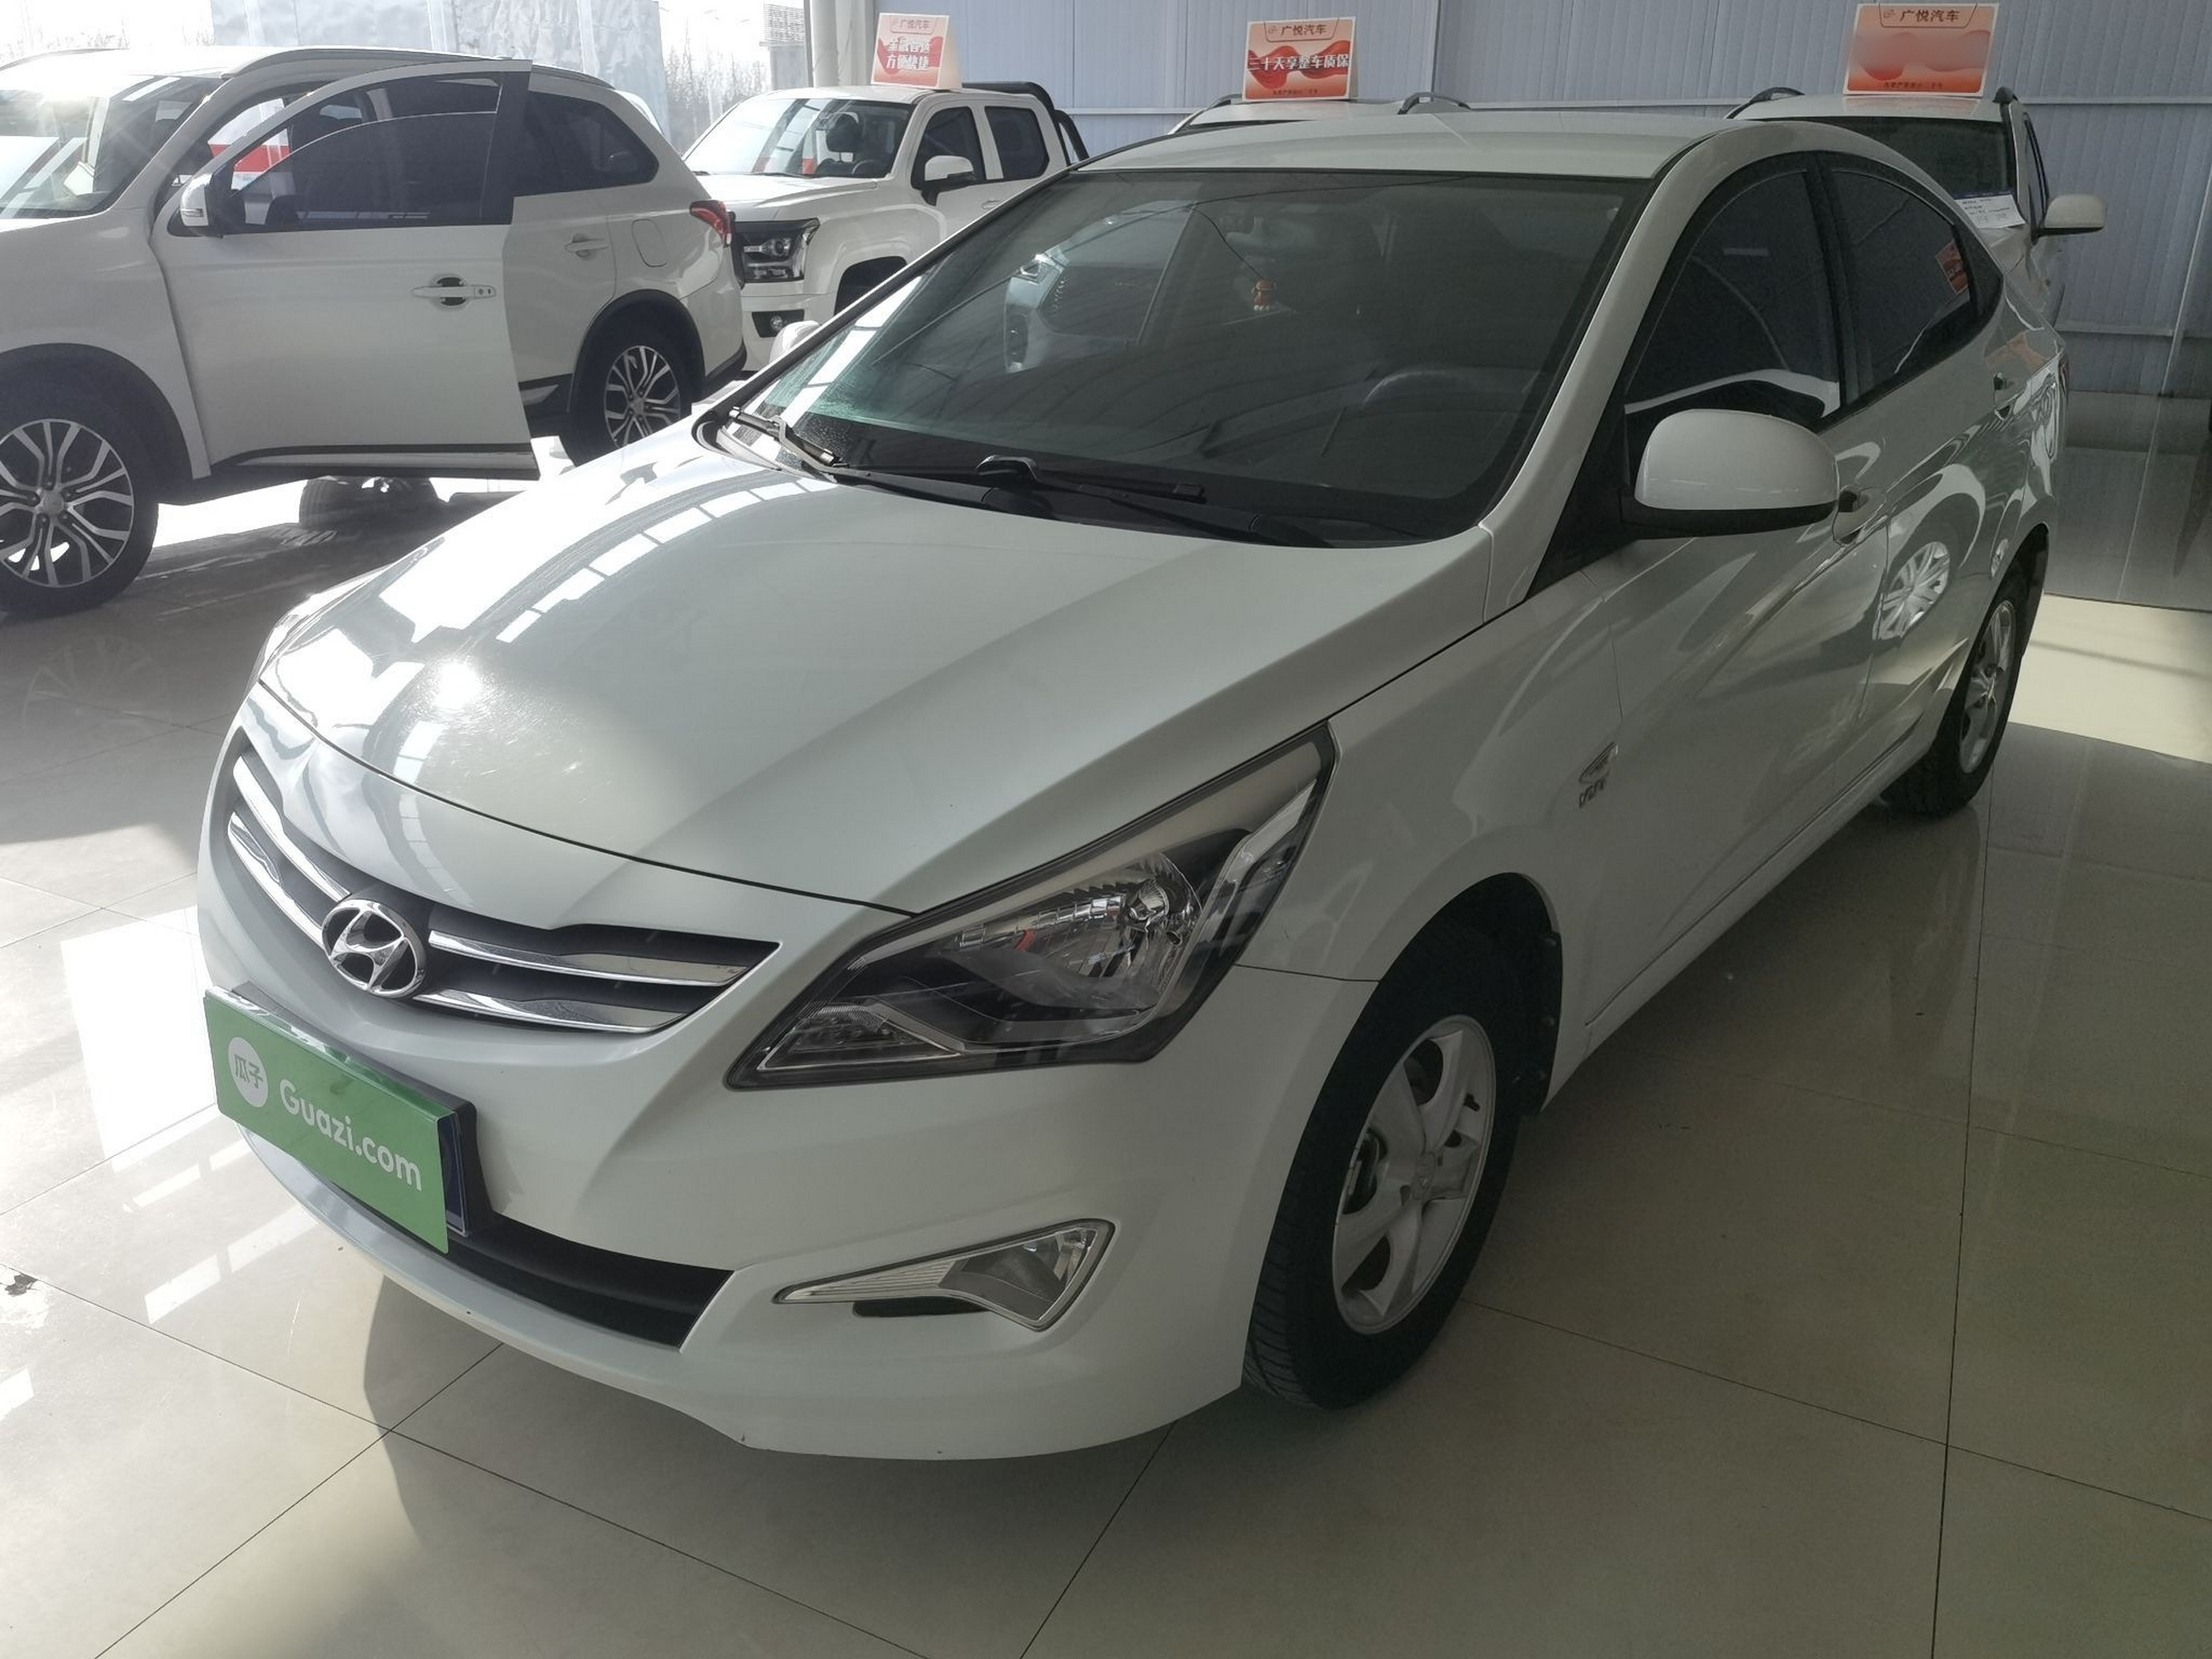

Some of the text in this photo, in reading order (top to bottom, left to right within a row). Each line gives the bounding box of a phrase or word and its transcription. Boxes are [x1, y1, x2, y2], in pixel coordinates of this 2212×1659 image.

[1900, 9, 1960, 22] 广悦汽车
[1280, 24, 1328, 36] 广悦汽车
[234, 1053, 264, 1089] 瓜子
[279, 1079, 422, 1192] Guazi.com
